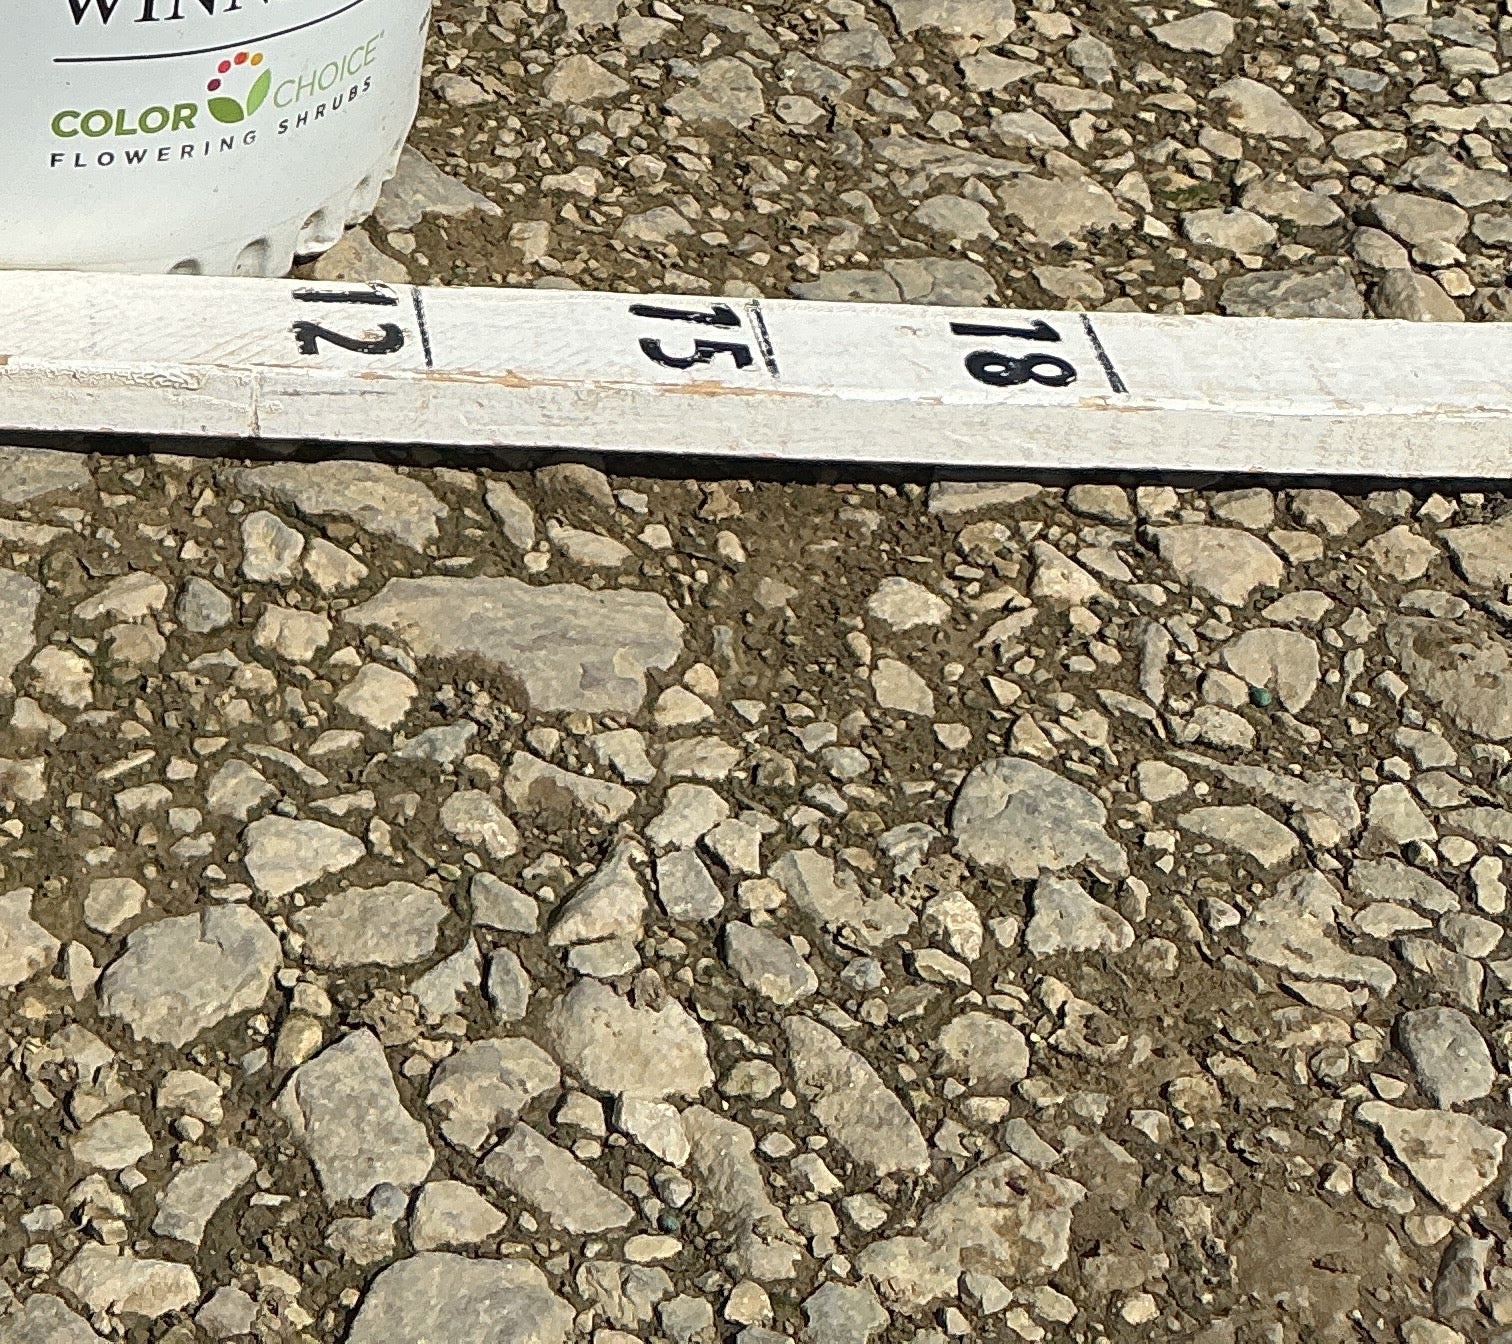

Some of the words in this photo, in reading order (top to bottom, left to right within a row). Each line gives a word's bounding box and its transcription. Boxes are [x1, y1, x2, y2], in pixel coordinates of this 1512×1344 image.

[50, 130, 257, 168] FLOWERING
[277, 75, 373, 135] SHRUBS
[51, 102, 199, 138] COLOR
[291, 282, 405, 356] 12
[628, 301, 752, 372] 15
[950, 319, 1077, 388] 18
